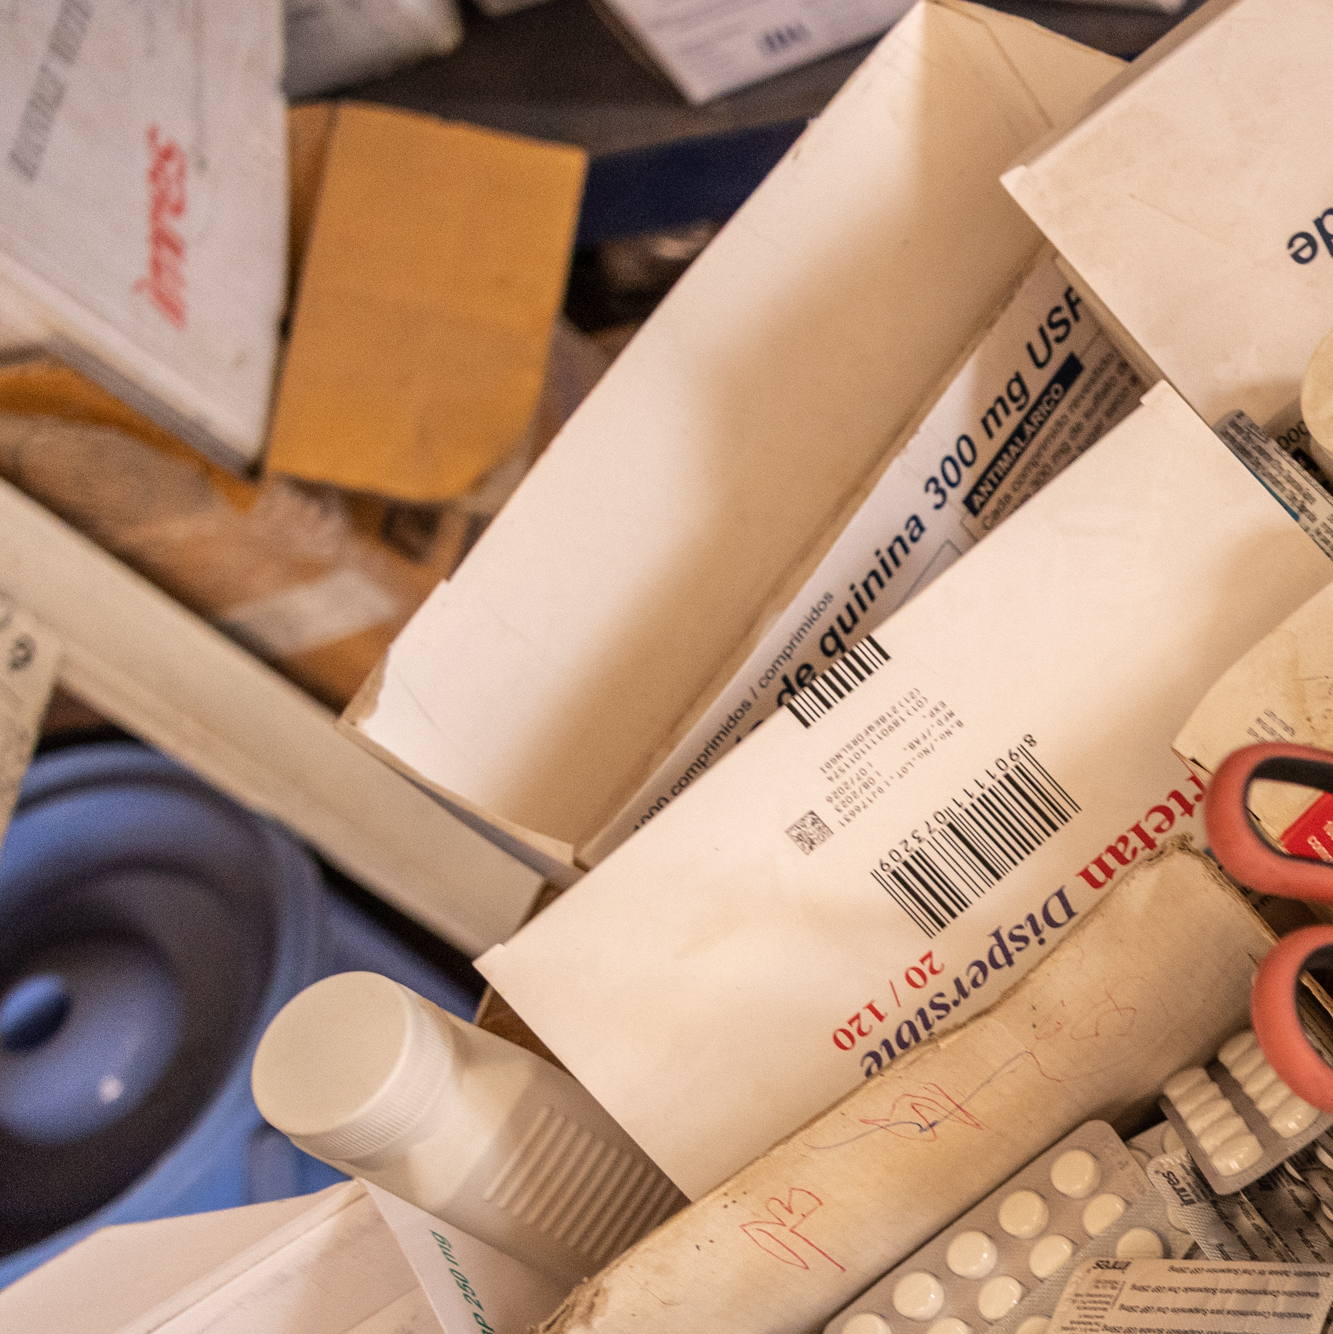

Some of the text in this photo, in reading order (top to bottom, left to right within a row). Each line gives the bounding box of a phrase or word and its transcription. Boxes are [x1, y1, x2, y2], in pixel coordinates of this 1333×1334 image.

[818, 514, 926, 660] quinina
[924, 433, 979, 511] 300
[980, 370, 1031, 440] mg
[671, 699, 752, 798] comprimidos
[760, 592, 834, 690] comprimidos
[861, 886, 1078, 1079] Dispersible
[904, 950, 943, 990] 20
[832, 1002, 886, 1052] 120
[430, 1230, 461, 1267] mg
[449, 1267, 485, 1311] 250
